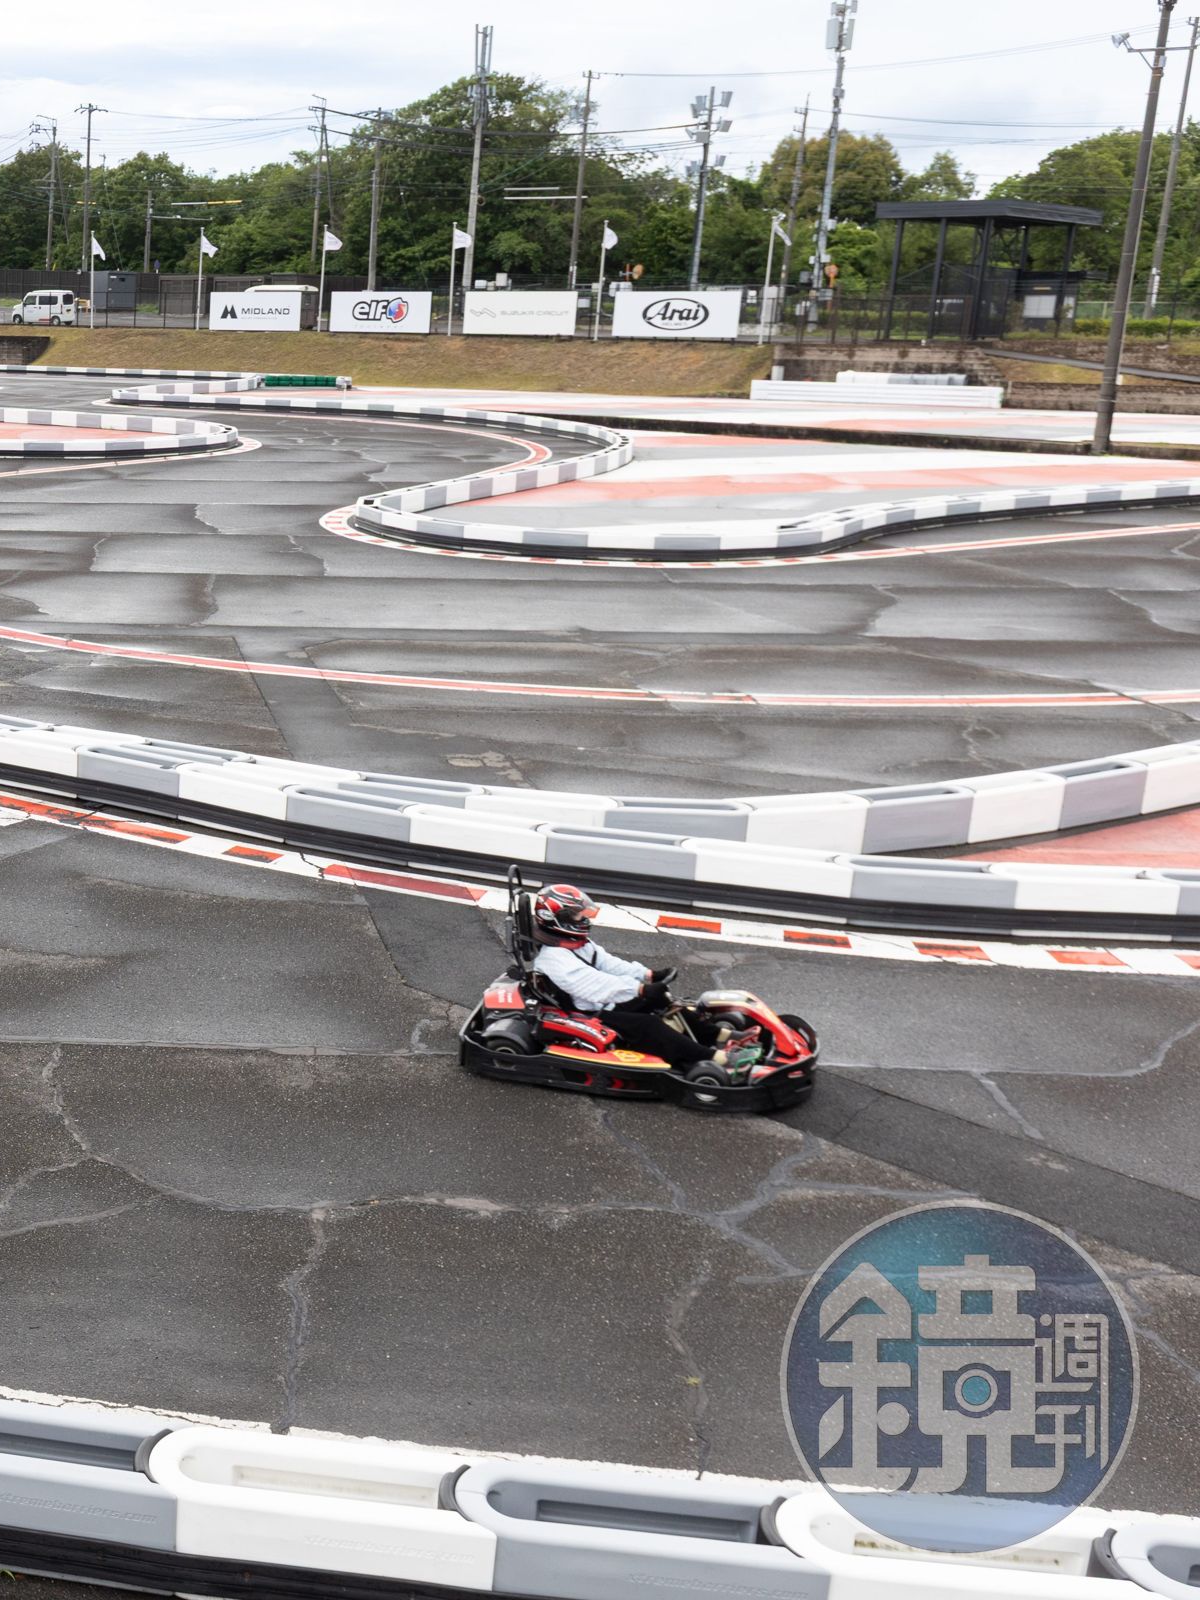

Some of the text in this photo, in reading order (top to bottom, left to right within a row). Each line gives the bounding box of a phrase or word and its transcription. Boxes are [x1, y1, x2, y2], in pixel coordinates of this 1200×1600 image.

[241, 307, 290, 315] MIDLAND
[352, 299, 389, 321] elf
[646, 301, 700, 321] Arai
